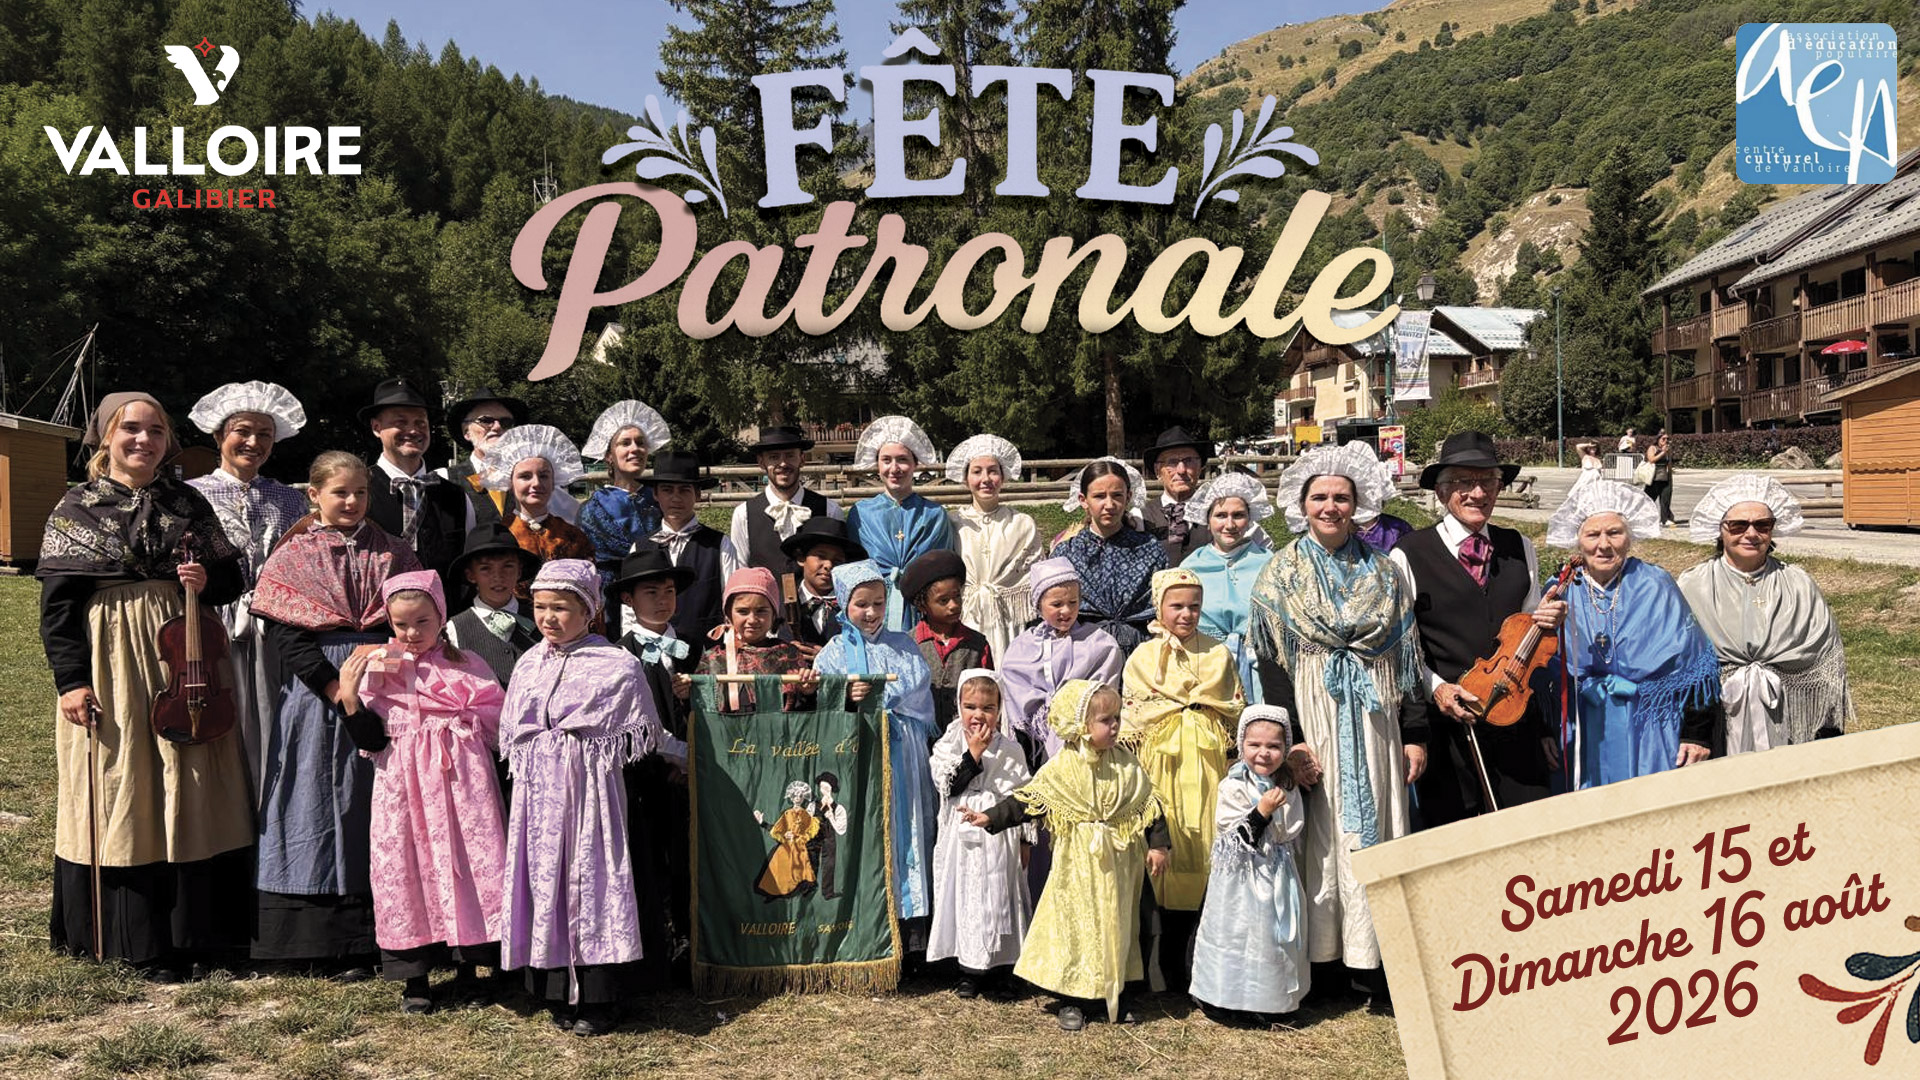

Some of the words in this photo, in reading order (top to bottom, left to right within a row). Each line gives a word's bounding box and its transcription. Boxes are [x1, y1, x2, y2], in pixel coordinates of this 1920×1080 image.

[728, 738, 757, 754] La
[771, 740, 820, 758] vallée
[740, 921, 796, 936] VALLOIRE
